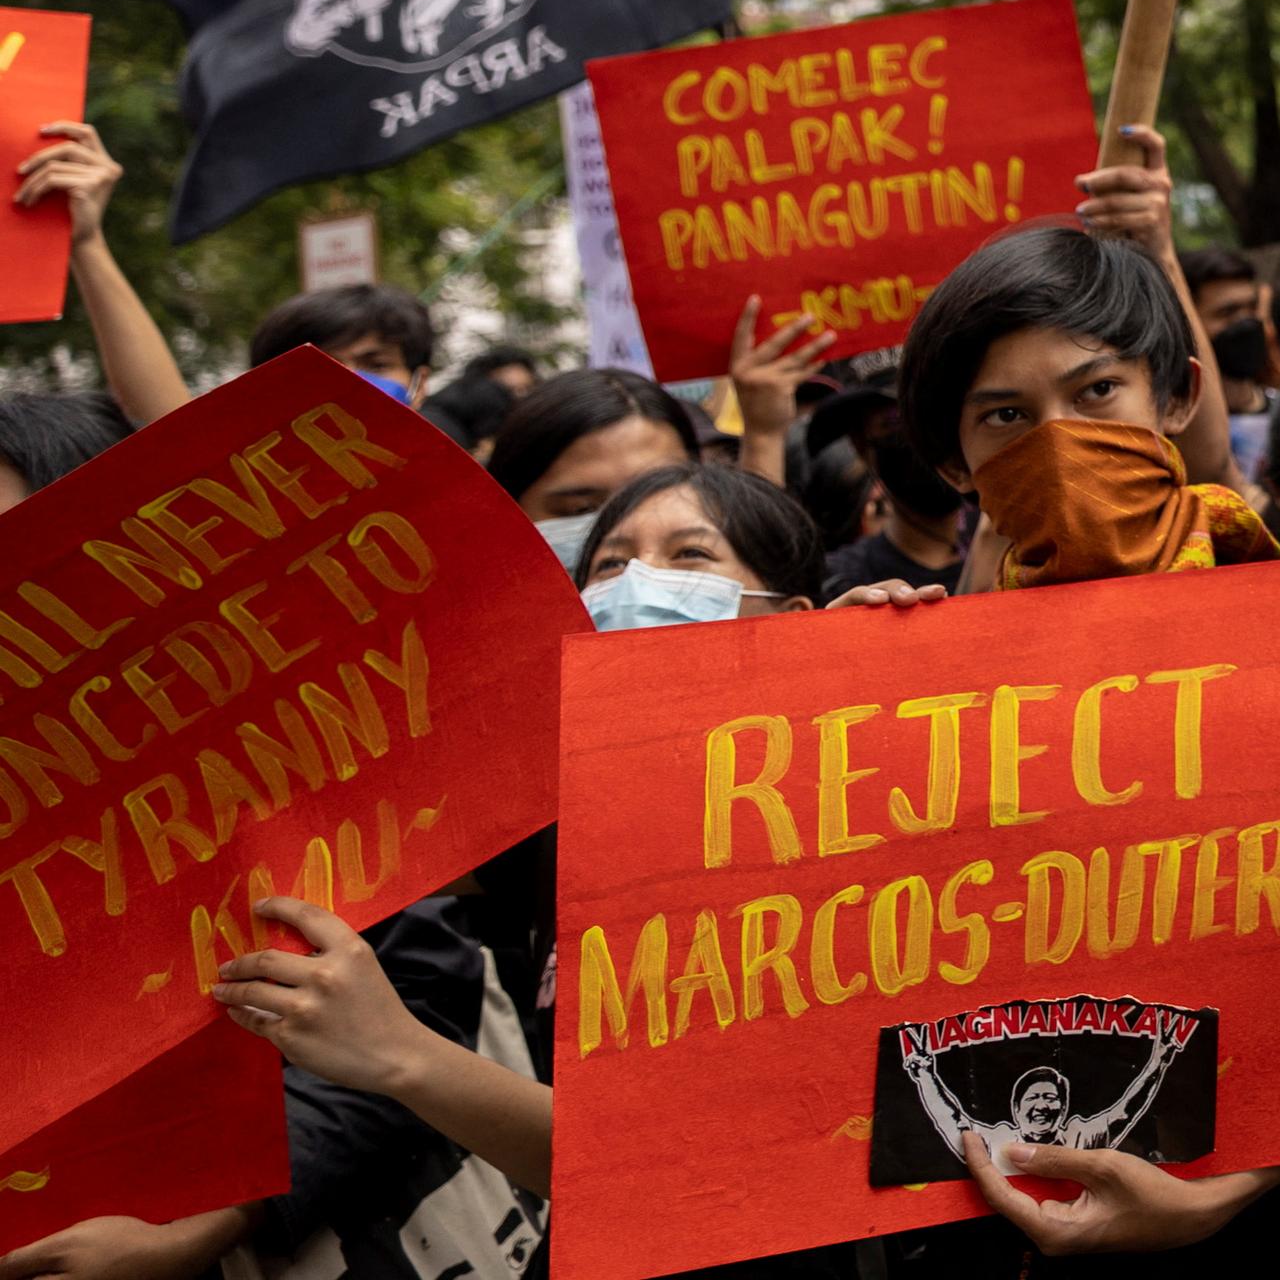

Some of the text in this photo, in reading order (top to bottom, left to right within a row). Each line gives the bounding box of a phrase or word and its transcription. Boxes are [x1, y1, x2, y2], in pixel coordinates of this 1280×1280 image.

[663, 36, 948, 124] COMELEC
[676, 94, 949, 197] PALPAK!
[657, 156, 1025, 271] PANAGUTIN!
[82, 402, 408, 607] NEVER
[286, 511, 438, 624] TO
[0, 619, 433, 958] TYRANNY
[704, 664, 1240, 869] REJECT
